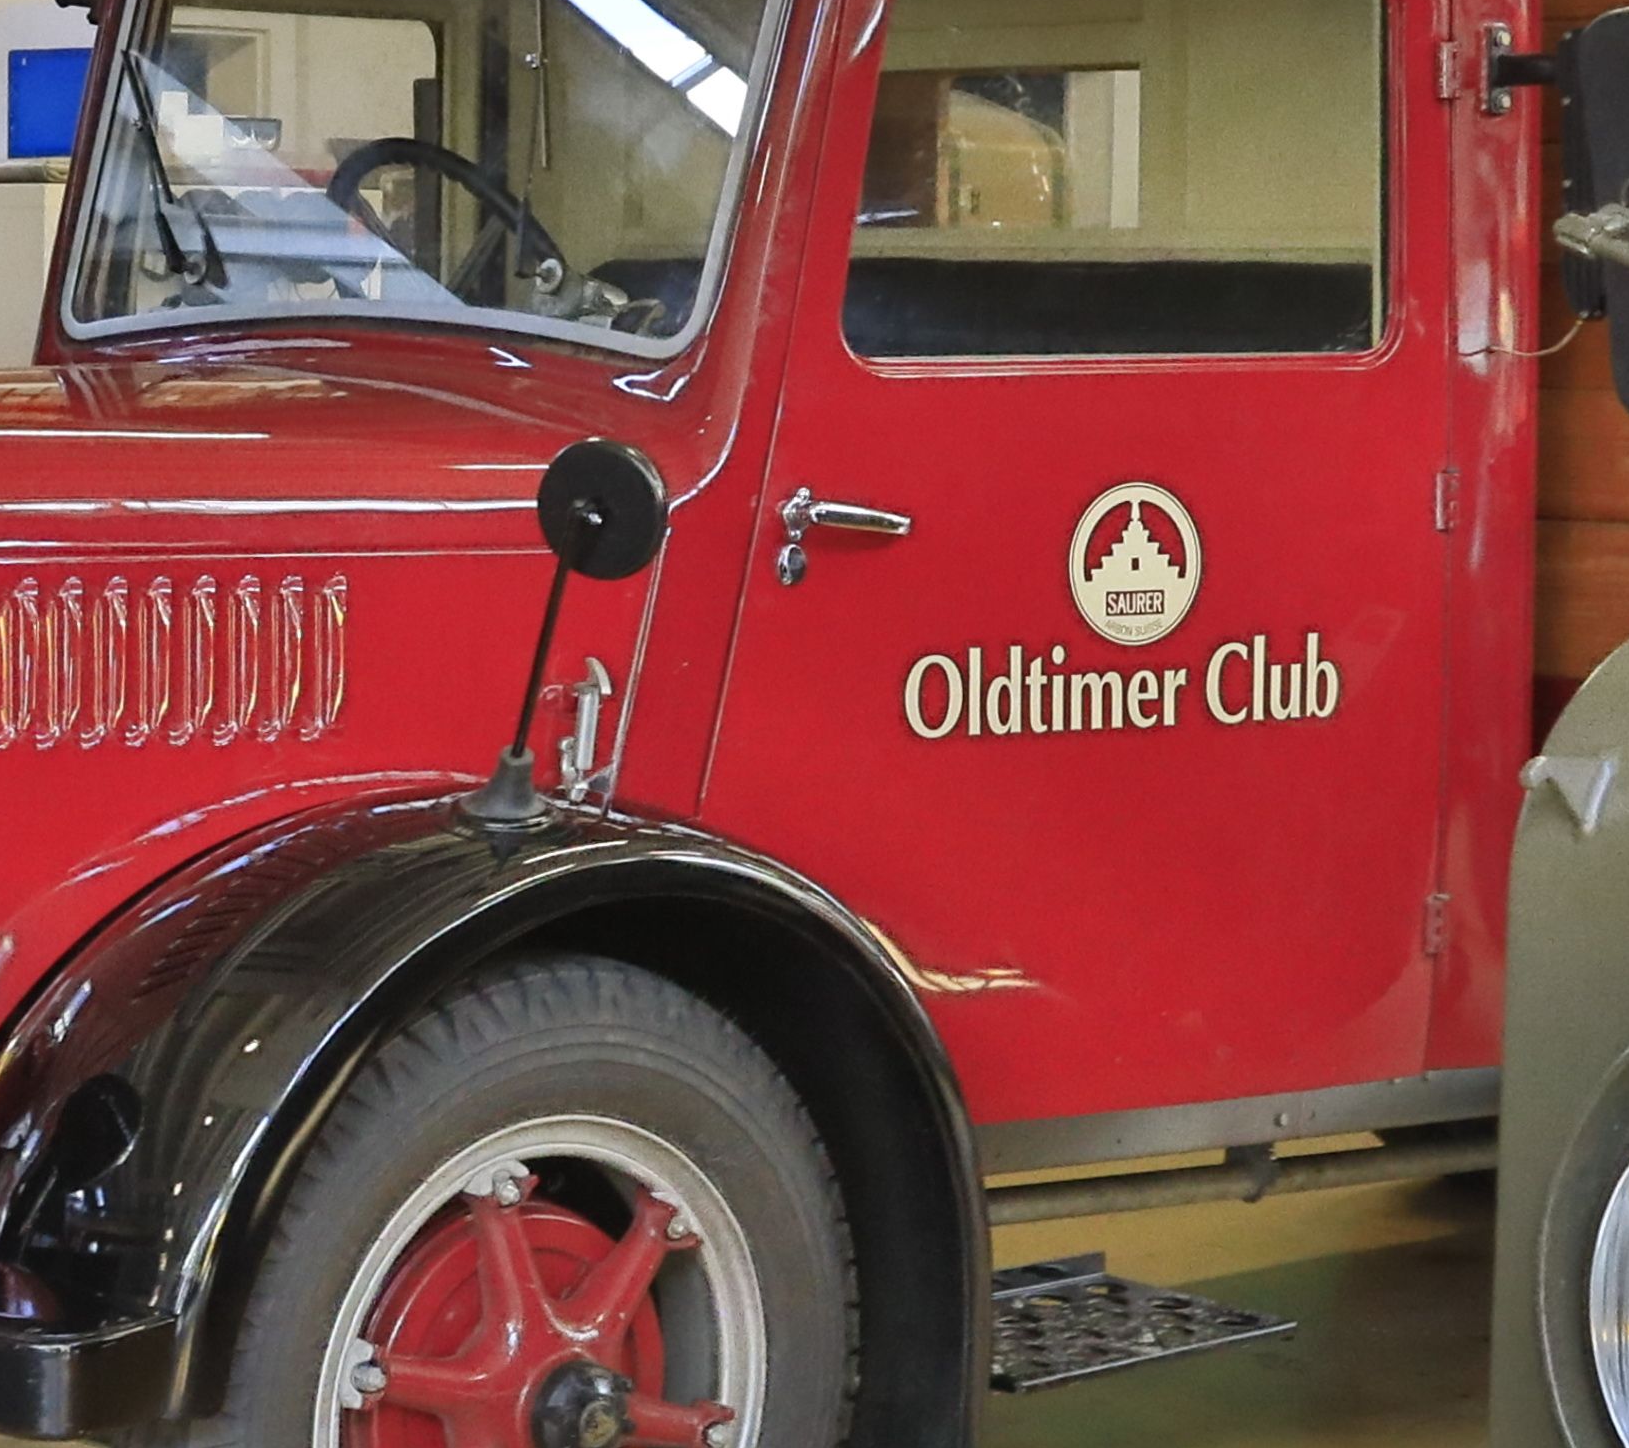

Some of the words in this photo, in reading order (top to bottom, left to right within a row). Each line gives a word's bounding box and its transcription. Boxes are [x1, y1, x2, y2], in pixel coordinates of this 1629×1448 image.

[1107, 591, 1163, 615] SAURER
[903, 644, 1187, 739] Oldtimer
[1206, 632, 1340, 725] Club
